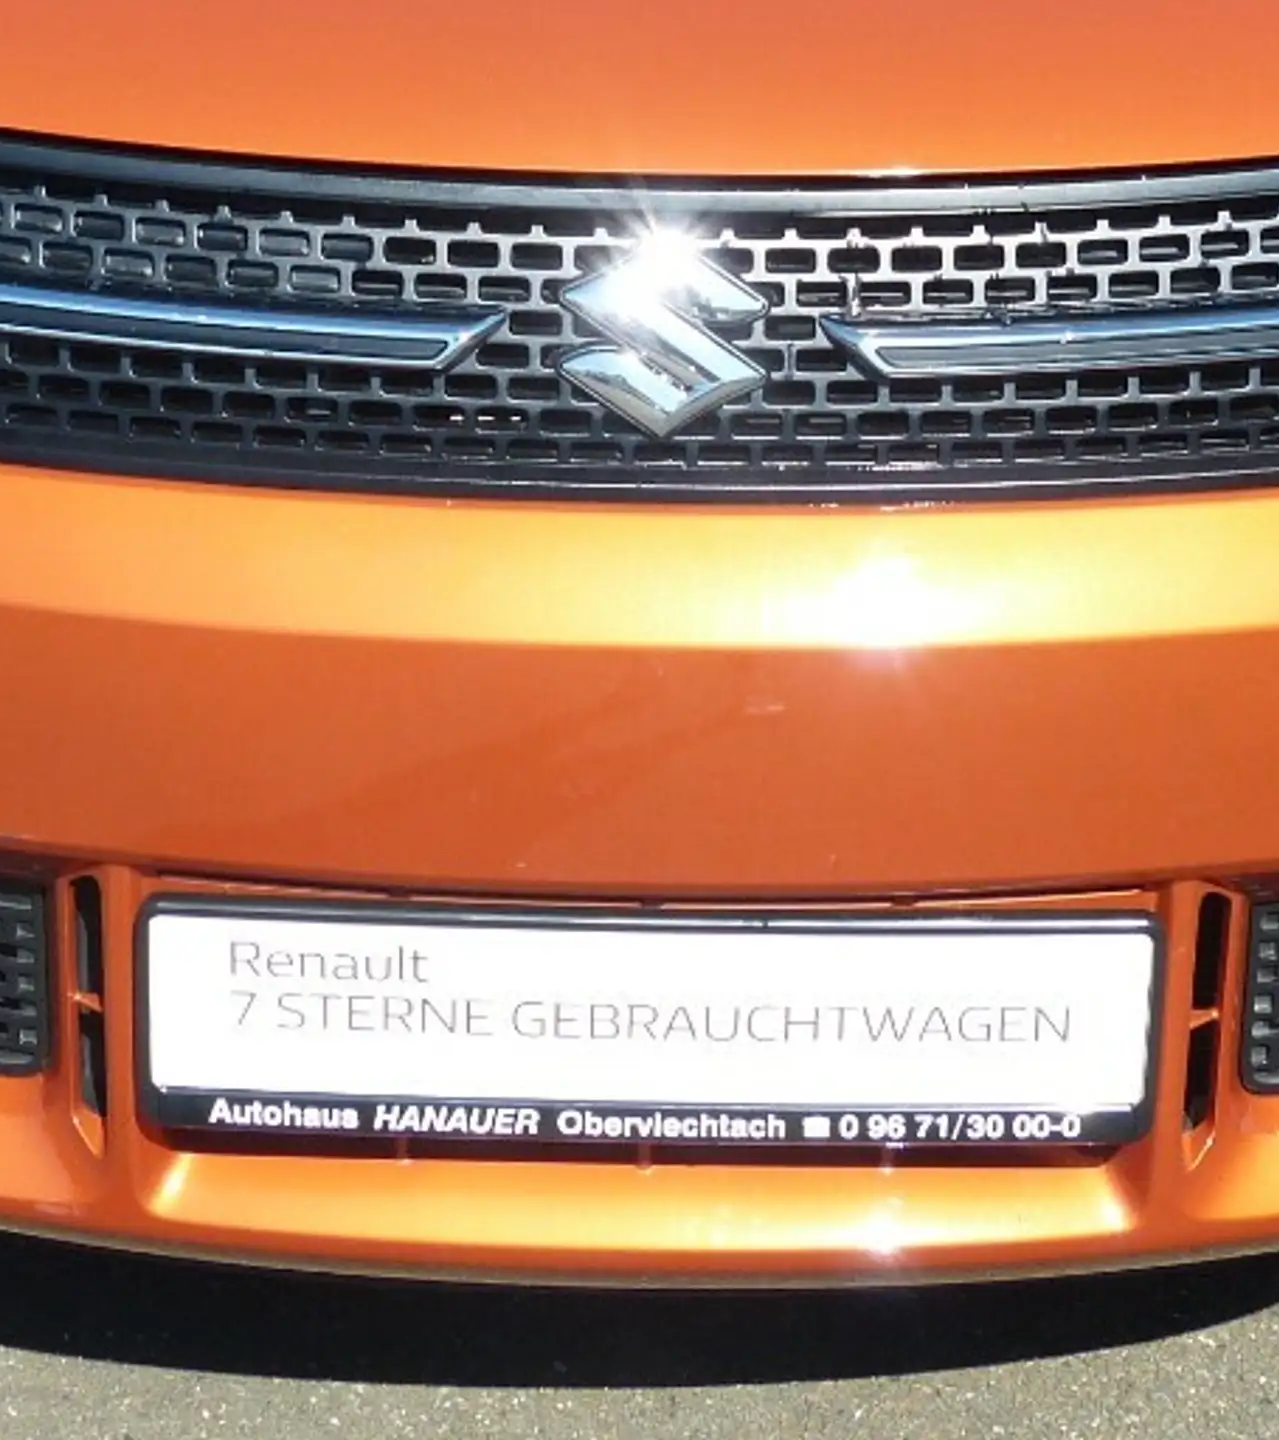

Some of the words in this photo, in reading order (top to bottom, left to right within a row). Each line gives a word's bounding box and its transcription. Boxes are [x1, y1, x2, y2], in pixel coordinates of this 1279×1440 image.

[229, 940, 429, 983] Renault
[229, 989, 257, 1027] 7
[276, 991, 494, 1037] STERNE
[511, 1000, 1071, 1044] GEBRAUCHTWAGEN
[208, 1098, 360, 1130] Autohaus
[372, 1104, 543, 1136] HANAUER
[838, 1113, 860, 1140] 0
[866, 1113, 907, 1140] 96
[914, 1113, 1006, 1142] 71/30
[1011, 1114, 1082, 1141] 00-0
